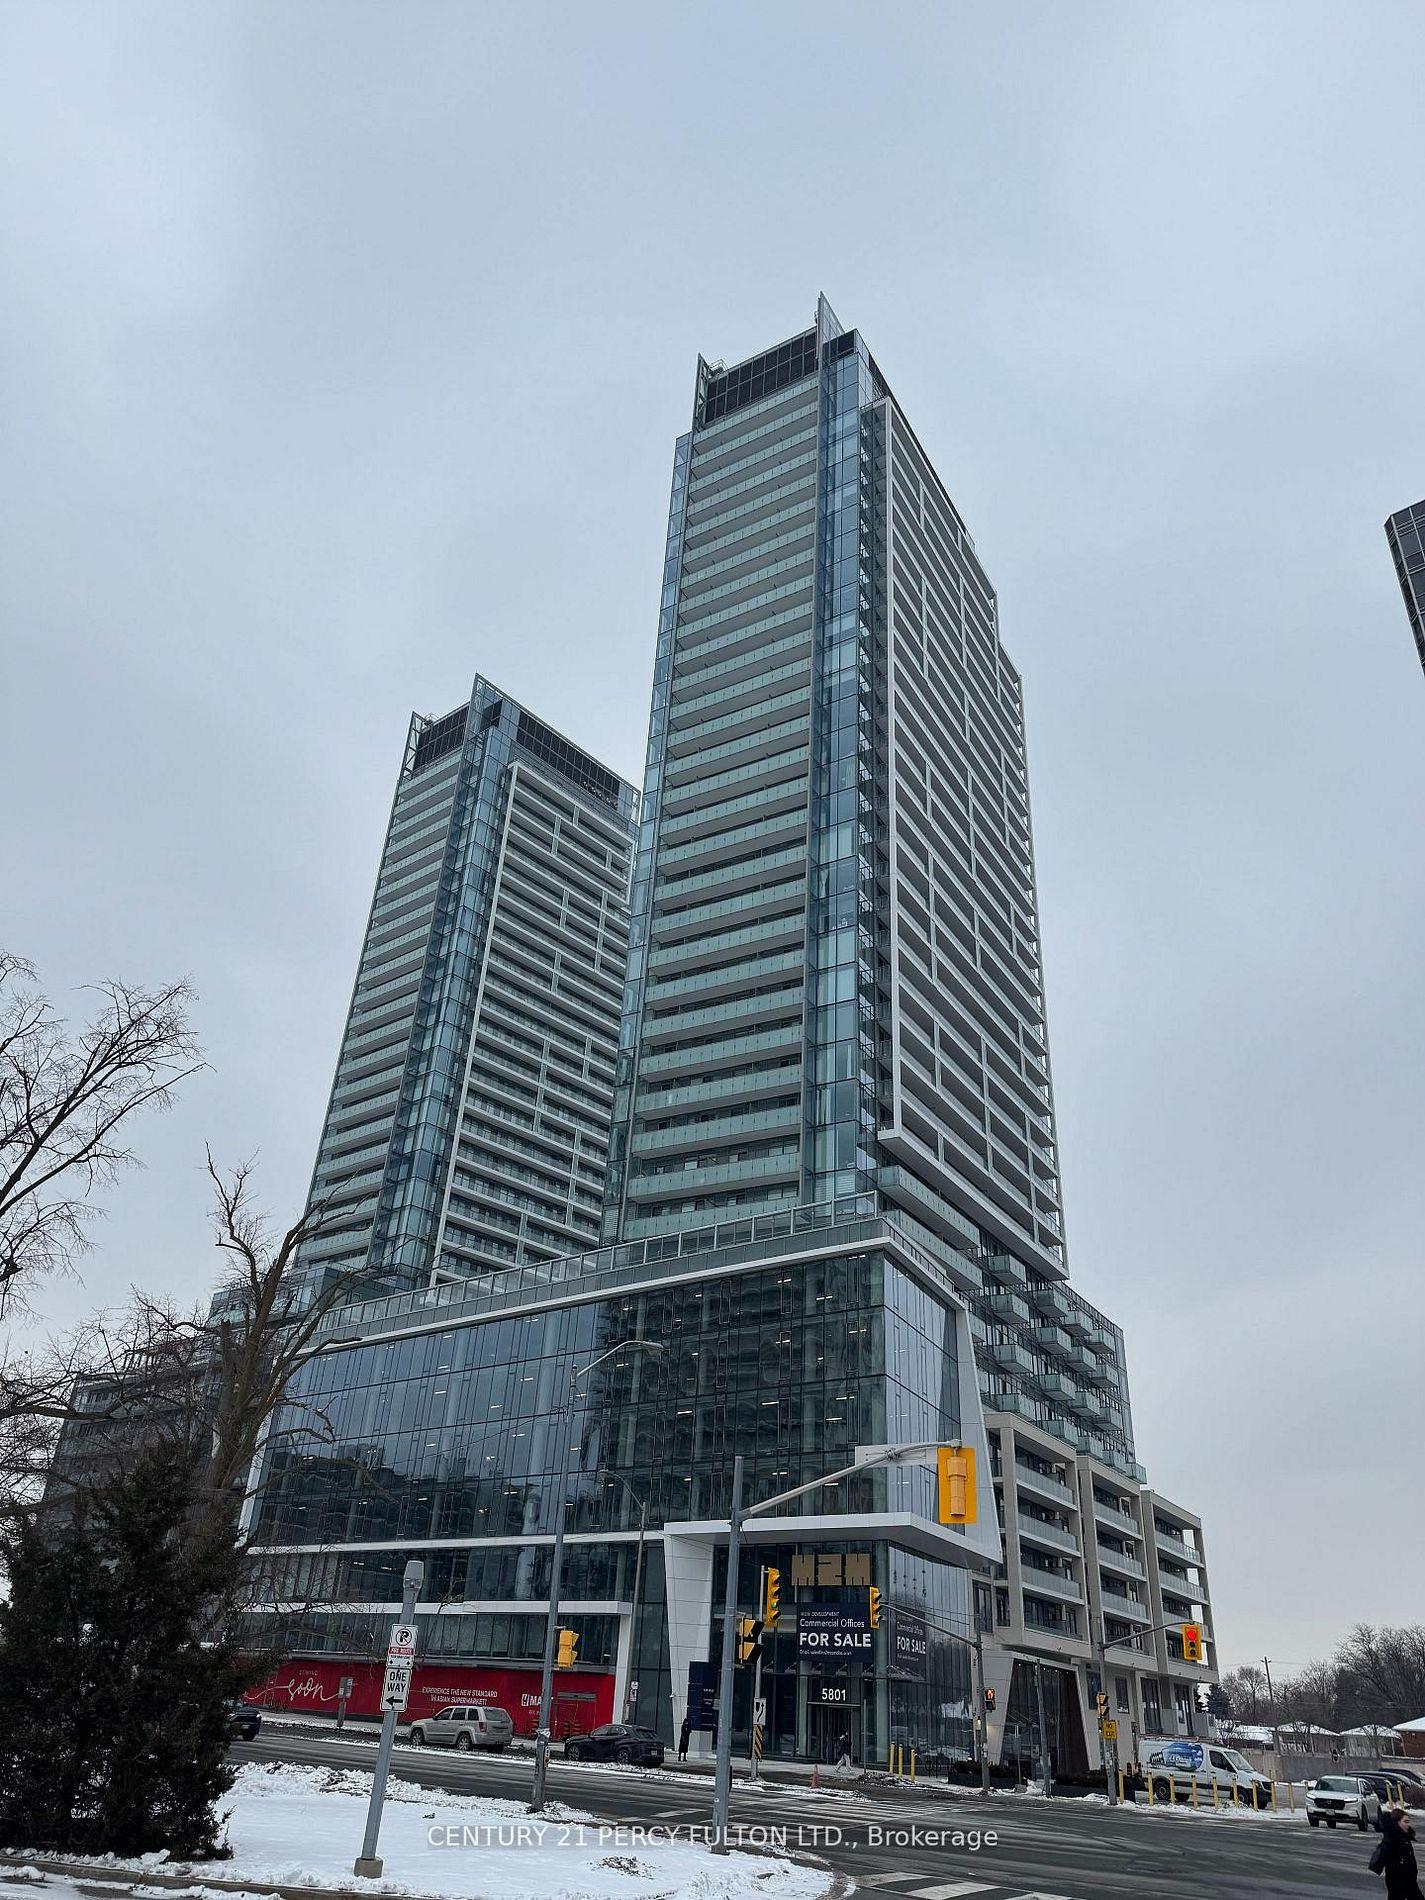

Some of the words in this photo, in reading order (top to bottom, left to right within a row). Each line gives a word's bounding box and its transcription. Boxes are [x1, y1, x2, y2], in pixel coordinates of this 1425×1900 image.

[800, 1618, 839, 1628] Commercial
[840, 1618, 865, 1628] Offices
[799, 1632, 830, 1647] FOR
[833, 1633, 872, 1648] SALE
[896, 1636, 911, 1652] FOR
[911, 1639, 926, 1655] SALE
[389, 1671, 407, 1682] ONE
[387, 1682, 407, 1693] WAY
[422, 1686, 450, 1696] EXPERIENCE
[472, 1689, 498, 1698] STANDARD
[821, 1688, 847, 1701] 5801
